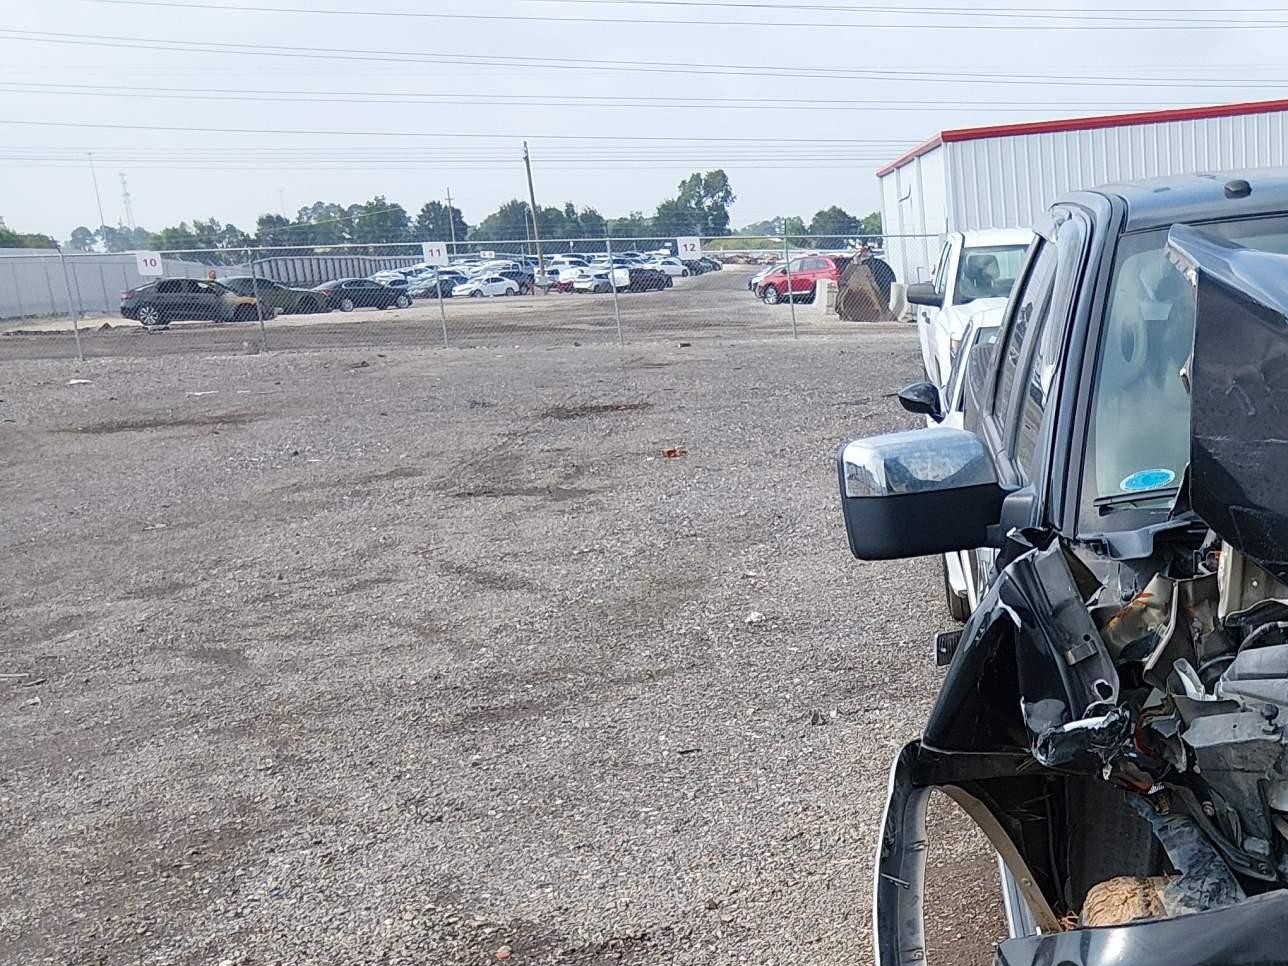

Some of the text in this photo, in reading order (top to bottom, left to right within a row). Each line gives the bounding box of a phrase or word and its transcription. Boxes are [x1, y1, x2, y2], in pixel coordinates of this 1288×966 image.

[683, 243, 696, 252] 12
[429, 249, 441, 257] 11
[142, 258, 157, 267] 10
